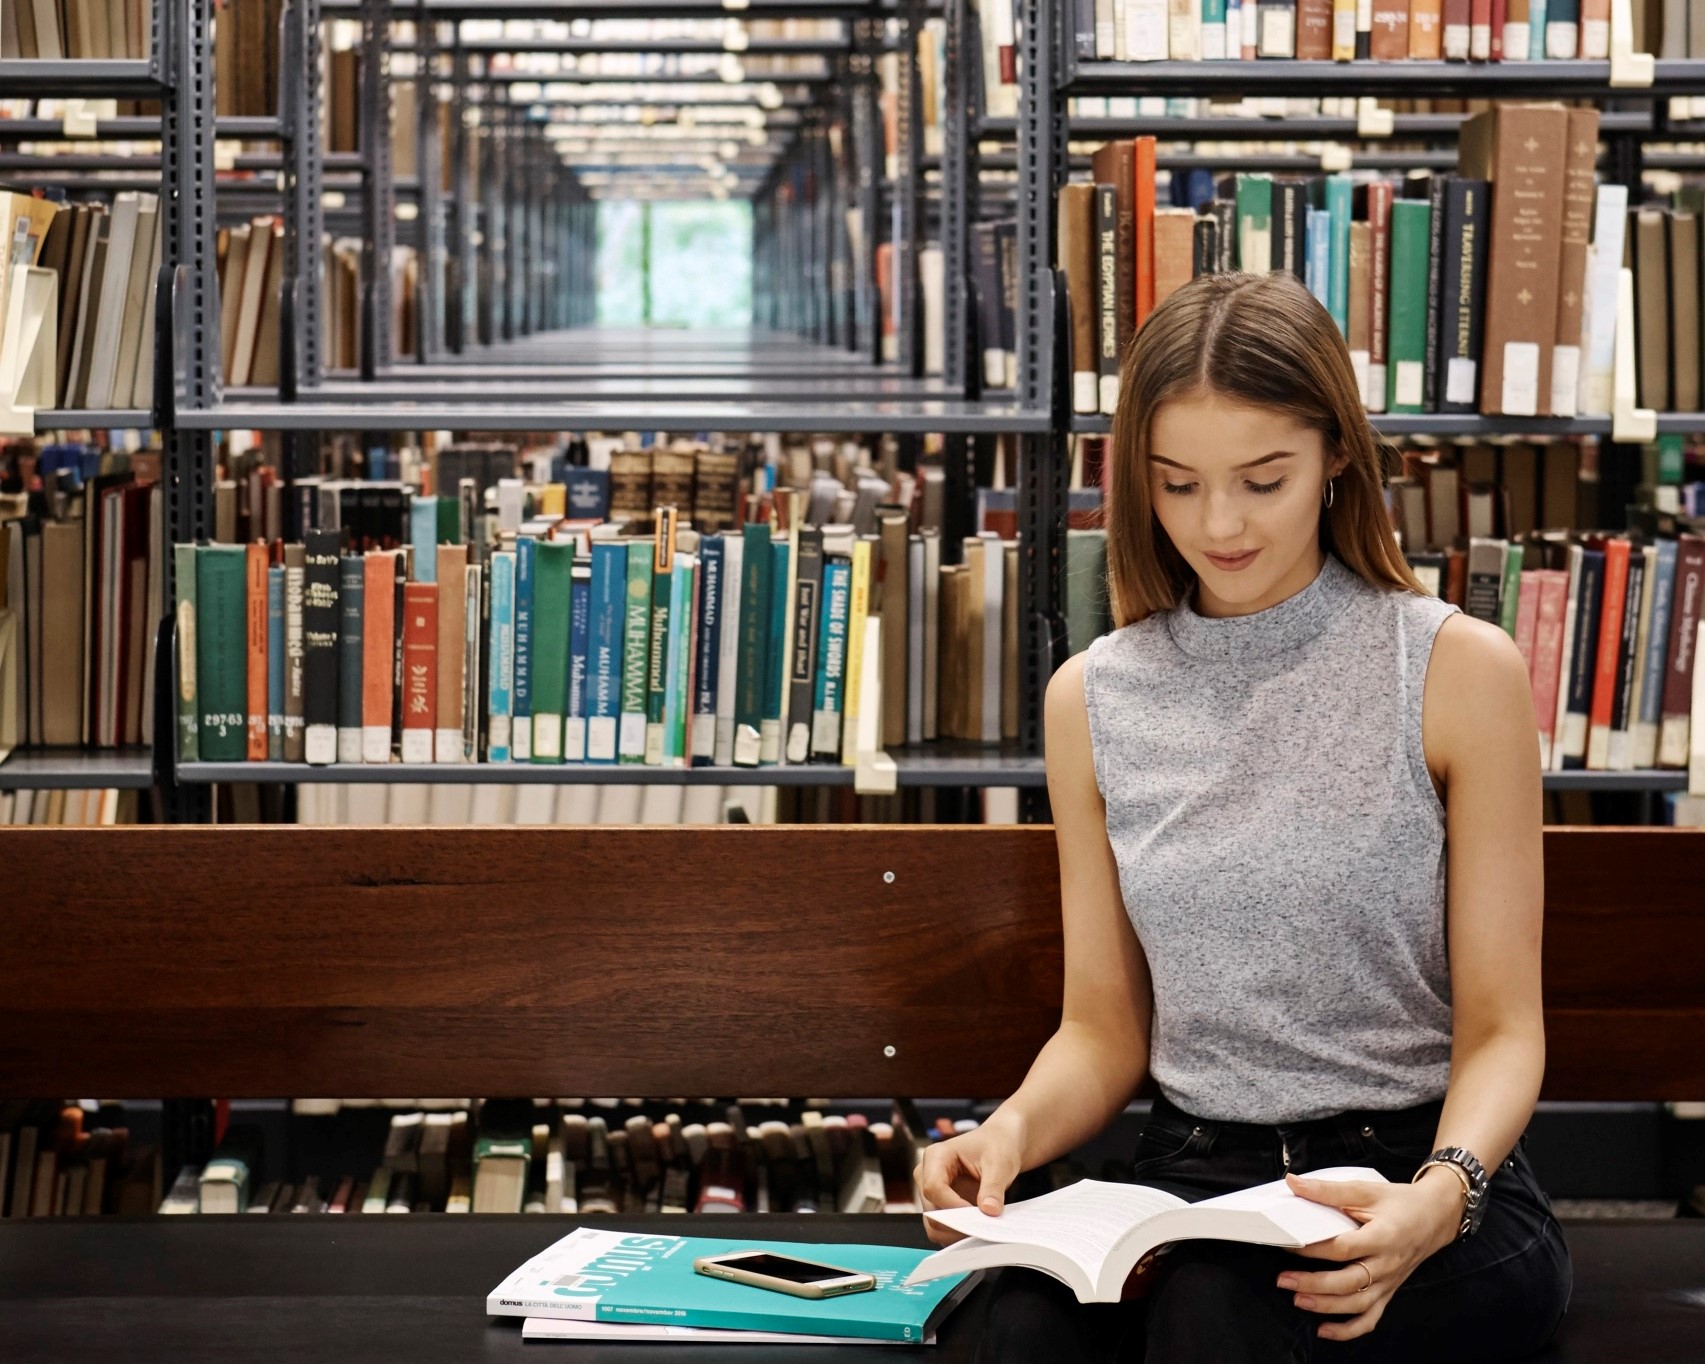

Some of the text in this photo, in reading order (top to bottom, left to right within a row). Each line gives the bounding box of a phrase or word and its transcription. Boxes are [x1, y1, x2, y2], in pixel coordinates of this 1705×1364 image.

[1101, 230, 1116, 358] THE EGYPTIAN HERMES
[1457, 223, 1475, 357] TRAVERSING ETERNI
[703, 559, 718, 625] MUHAMMAD
[832, 569, 849, 587] THE
[799, 607, 810, 627] War
[829, 589, 847, 620] SHADE
[650, 606, 668, 692] Muhammad
[798, 628, 809, 647] and
[828, 621, 845, 635] OF
[517, 611, 528, 698] MUHAMMAD
[825, 636, 844, 678] SWORDS
[571, 655, 586, 718] Muhamma
[596, 646, 611, 718] MUHAMM
[701, 691, 711, 714] ISLA
[616, 1307, 673, 1316] novembre/november
